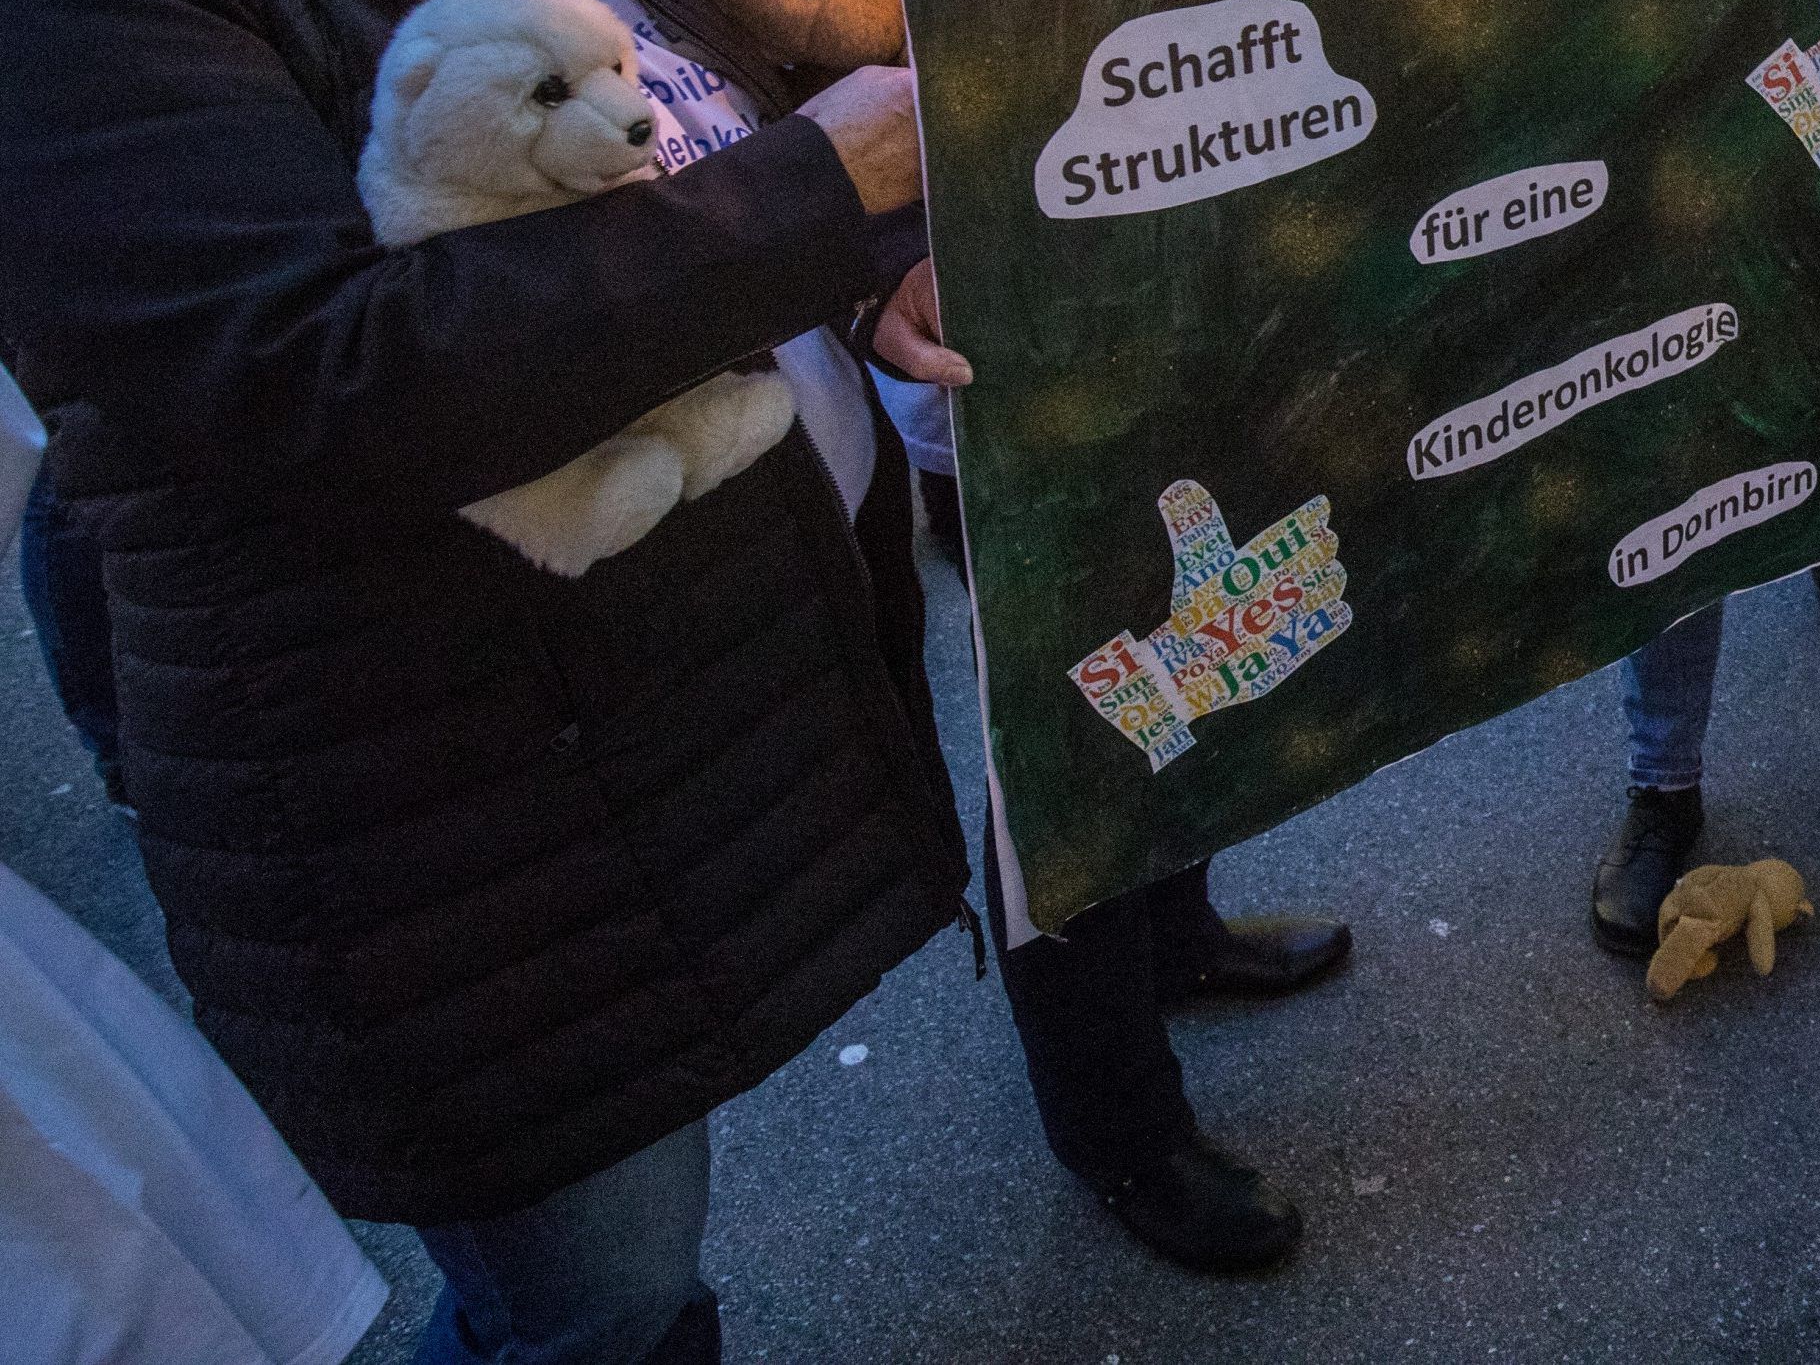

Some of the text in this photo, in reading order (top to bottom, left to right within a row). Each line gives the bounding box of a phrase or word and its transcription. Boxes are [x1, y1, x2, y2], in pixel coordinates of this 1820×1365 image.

[1101, 20, 1303, 107] Schafft
[1762, 52, 1806, 104] Si
[1061, 93, 1364, 206] Strukturen
[1421, 175, 1594, 257] für eine
[1413, 304, 1738, 476] Kinderonkologie
[1177, 530, 1229, 573] Evet
[1222, 519, 1310, 596] Oui
[1614, 465, 1815, 583] in Dornbirn
[1180, 550, 1235, 597] Ano
[1195, 576, 1304, 659] Yes
[1264, 607, 1337, 660] Ya
[1079, 639, 1143, 699] Si
[1217, 650, 1270, 702] Ja
